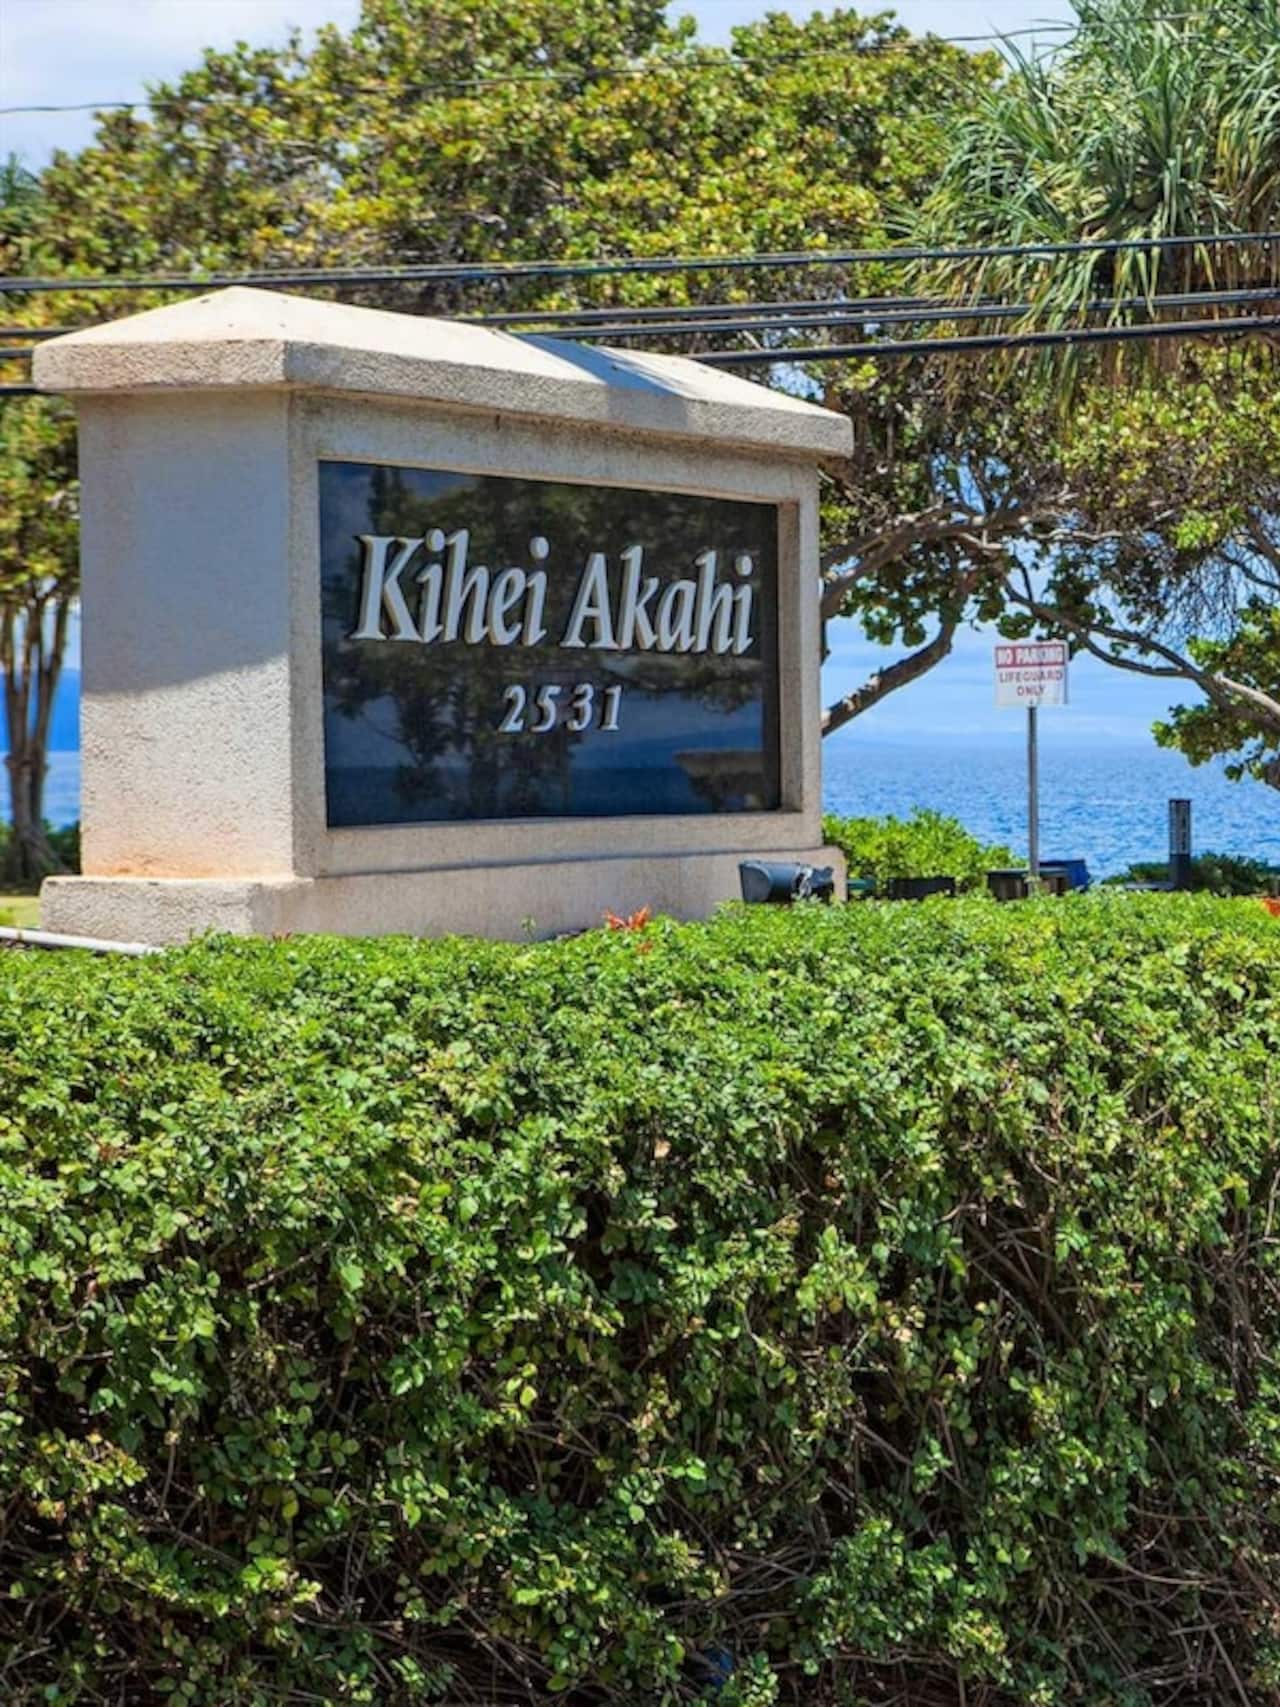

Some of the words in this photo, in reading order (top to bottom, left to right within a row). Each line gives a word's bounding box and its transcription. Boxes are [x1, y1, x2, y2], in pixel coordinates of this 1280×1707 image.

[351, 528, 548, 644] Kihei
[561, 546, 753, 654] Akahi
[997, 647, 1014, 665] NO
[1016, 647, 1062, 664] PARKING
[1000, 671, 1062, 682] LIFEGUARD
[1017, 686, 1044, 696] ONLY
[498, 682, 624, 733] 2531
